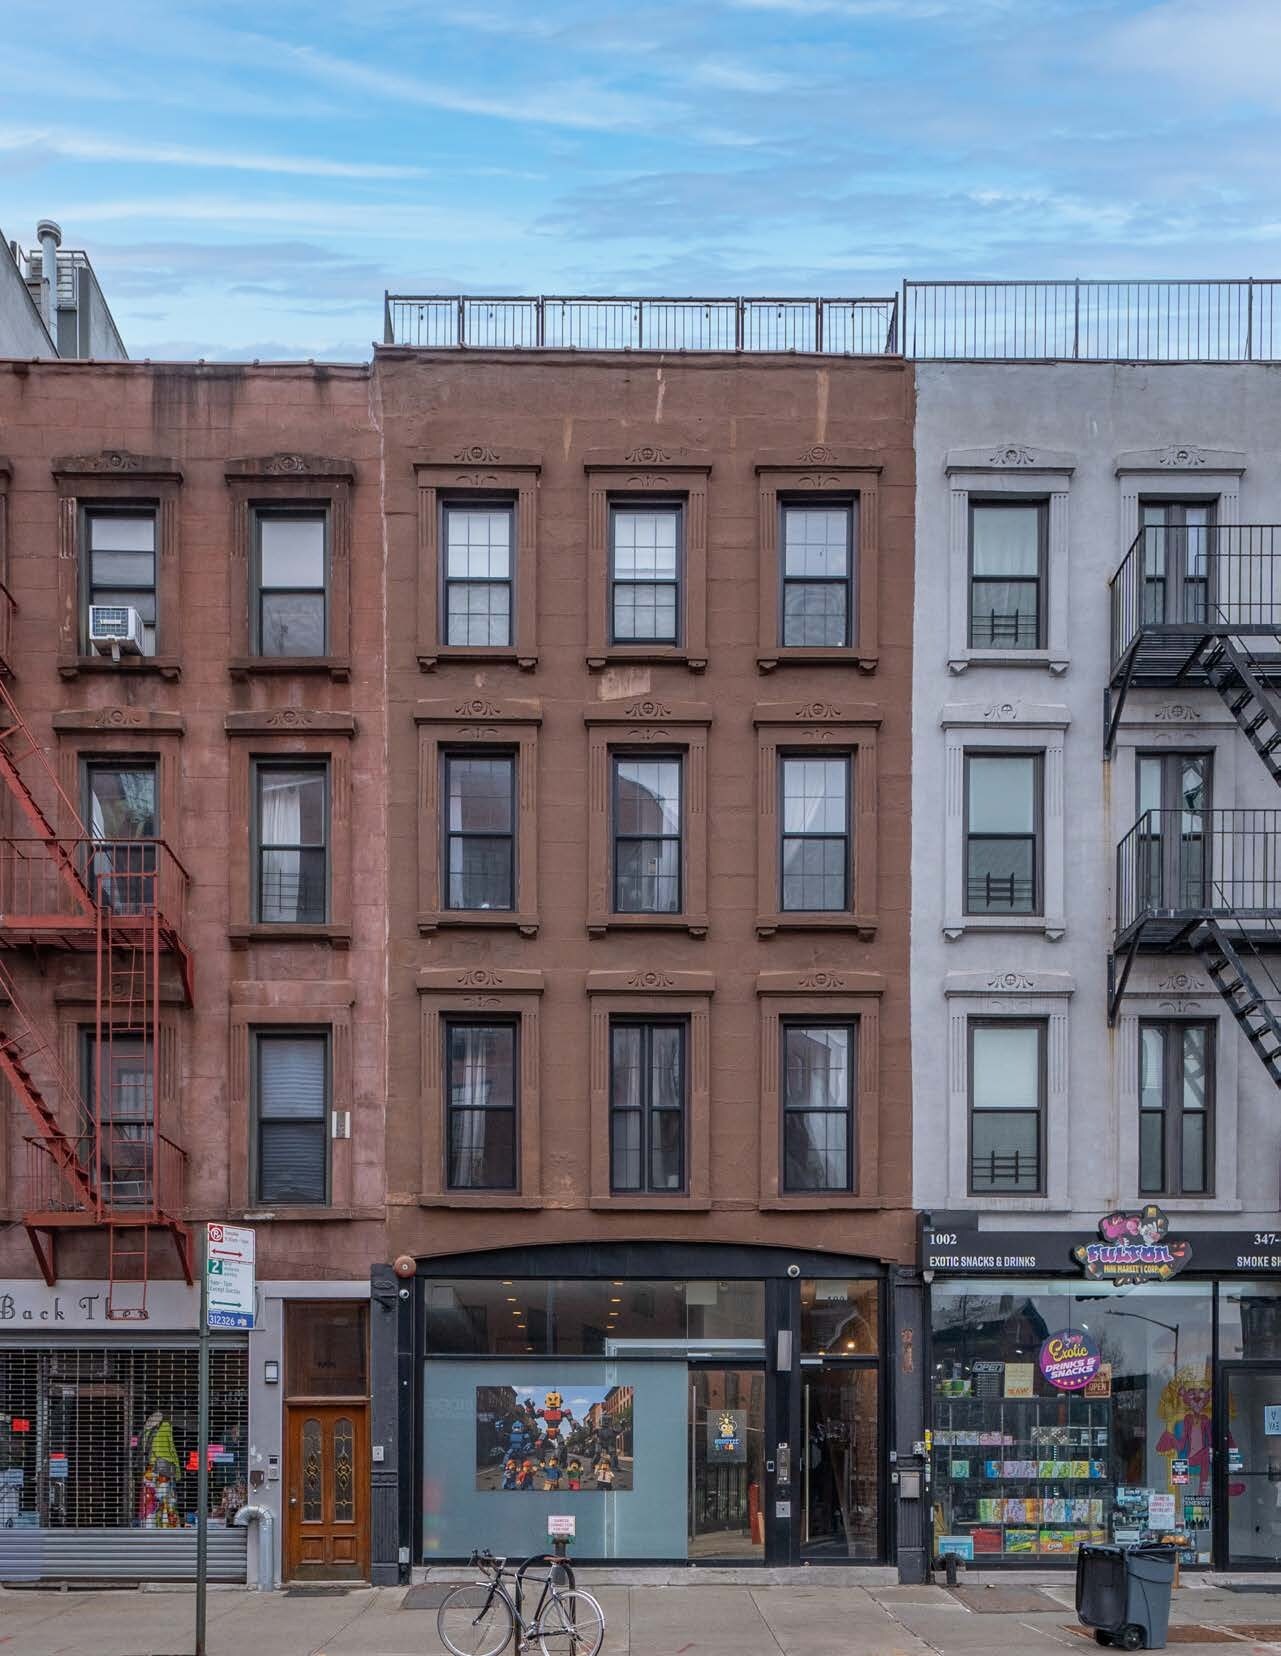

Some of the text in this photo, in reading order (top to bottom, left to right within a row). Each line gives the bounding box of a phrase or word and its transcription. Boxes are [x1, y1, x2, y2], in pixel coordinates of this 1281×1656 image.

[929, 1234, 957, 1245] 1002
[929, 1256, 1036, 1267] EXOTIC SNACKS & DRINKS
[1237, 1256, 1269, 1267] SMOKE
[1103, 1264, 1117, 1273] MINI
[1117, 1264, 1139, 1273] MARKET
[0, 1293, 64, 1320] Back
[208, 1315, 235, 1326] 312326
[1048, 1338, 1089, 1362] Exotic
[973, 1363, 1004, 1372] OPEN
[1045, 1357, 1097, 1373] DRINKS &
[1050, 1364, 1095, 1379] SNACKS
[1088, 1382, 1107, 1392] OPEN
